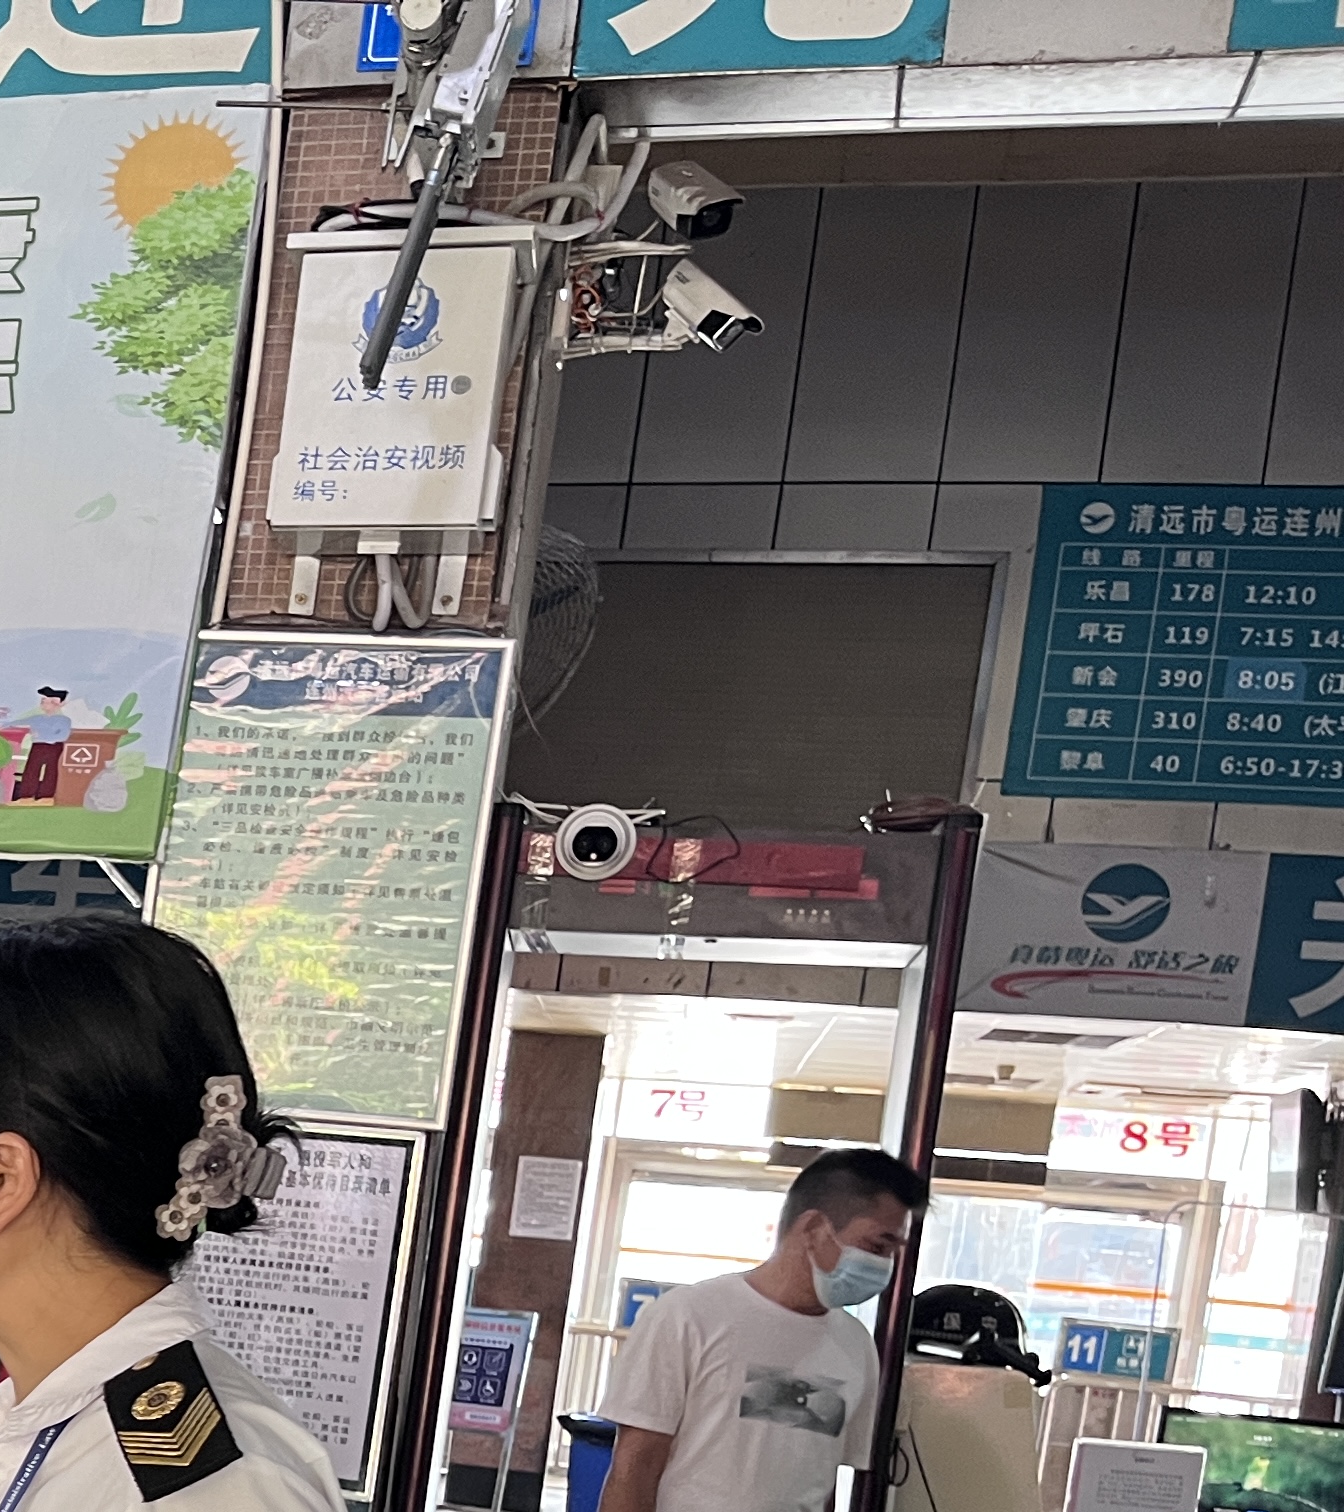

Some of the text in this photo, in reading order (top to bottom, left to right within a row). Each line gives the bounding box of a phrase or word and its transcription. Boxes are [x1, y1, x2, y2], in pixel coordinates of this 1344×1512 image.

[331, 375, 448, 404] 公安专用
[298, 444, 466, 472] 社会治安视频
[1170, 583, 1214, 601] 178
[1244, 584, 1317, 605] 12:10
[1164, 626, 1209, 645] 119
[1240, 627, 1294, 648] 7:15
[1158, 669, 1203, 687] 390
[1238, 670, 1295, 690] 8:05
[1152, 711, 1196, 730] 310
[1226, 713, 1282, 733] 8:40
[1150, 755, 1180, 772] 40
[650, 1088, 709, 1121] 7号
[1119, 1121, 1197, 1157] 8号
[1067, 1334, 1099, 1363] 11
